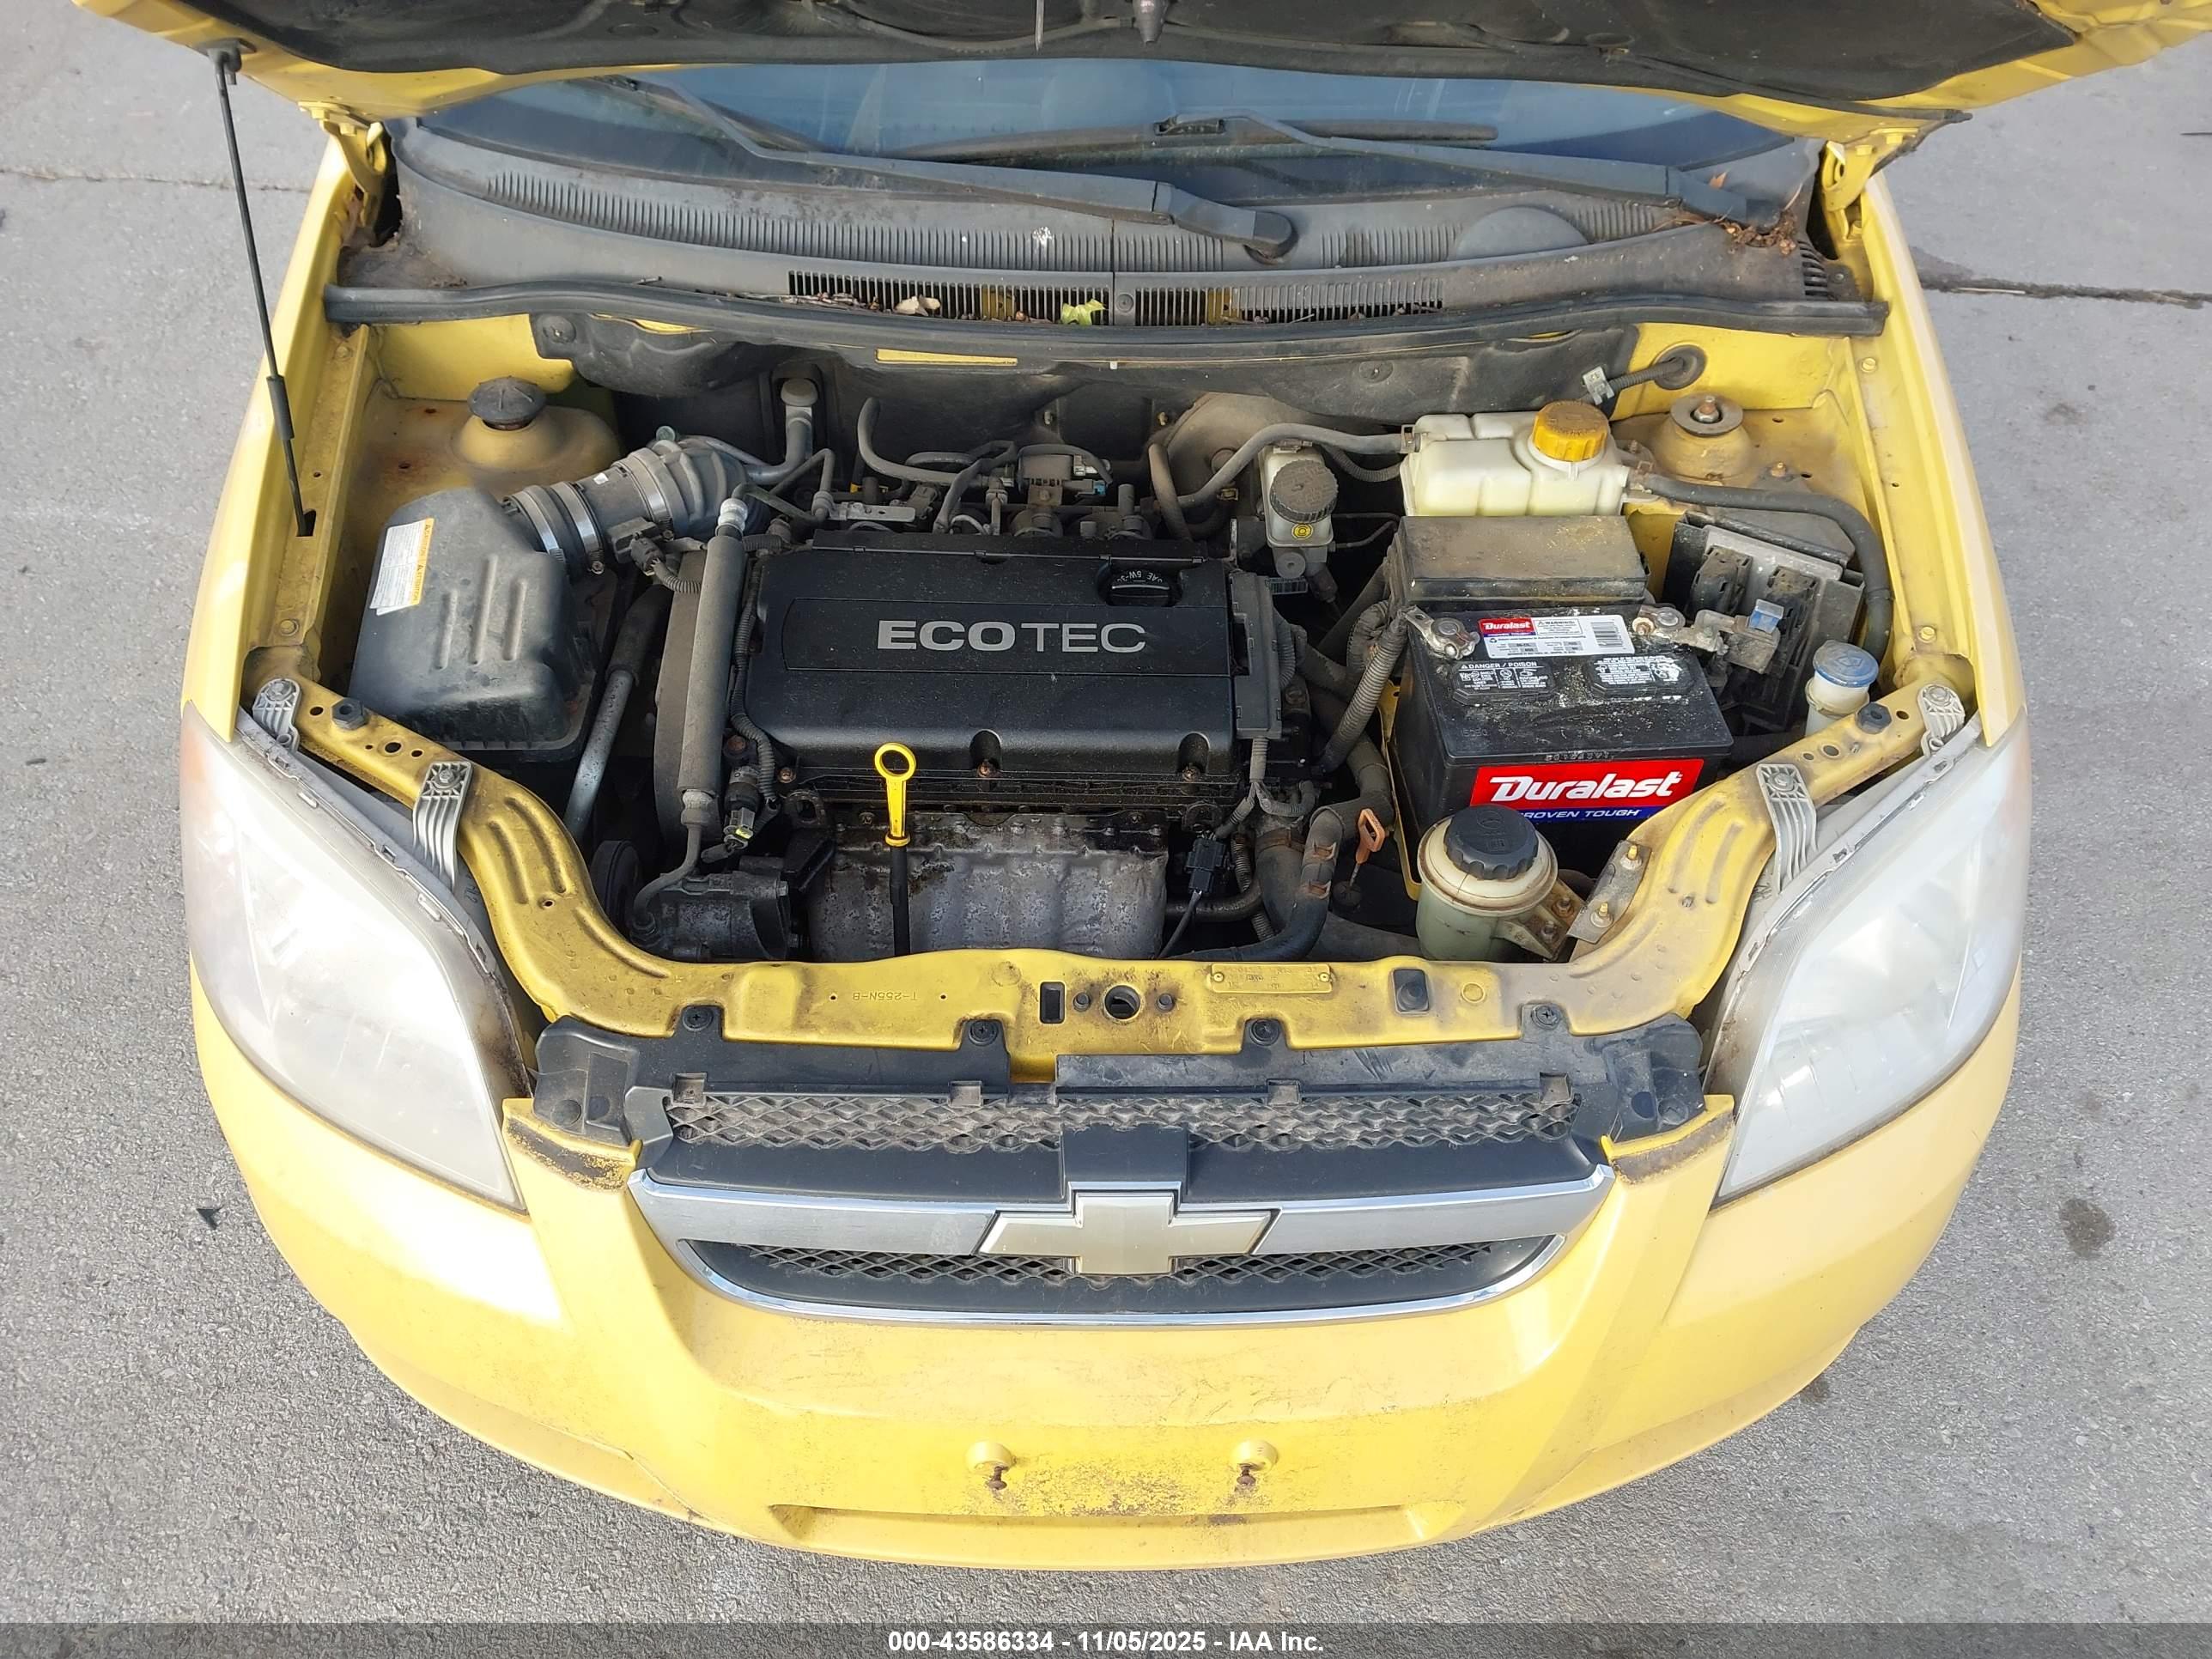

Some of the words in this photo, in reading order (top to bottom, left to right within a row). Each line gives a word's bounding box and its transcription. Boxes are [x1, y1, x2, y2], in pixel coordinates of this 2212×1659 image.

[1482, 621, 1531, 630] Duralast
[877, 619, 1146, 653] ECOTEC
[1490, 771, 1680, 802] Duralast
[1585, 809, 1639, 817] TOUGH
